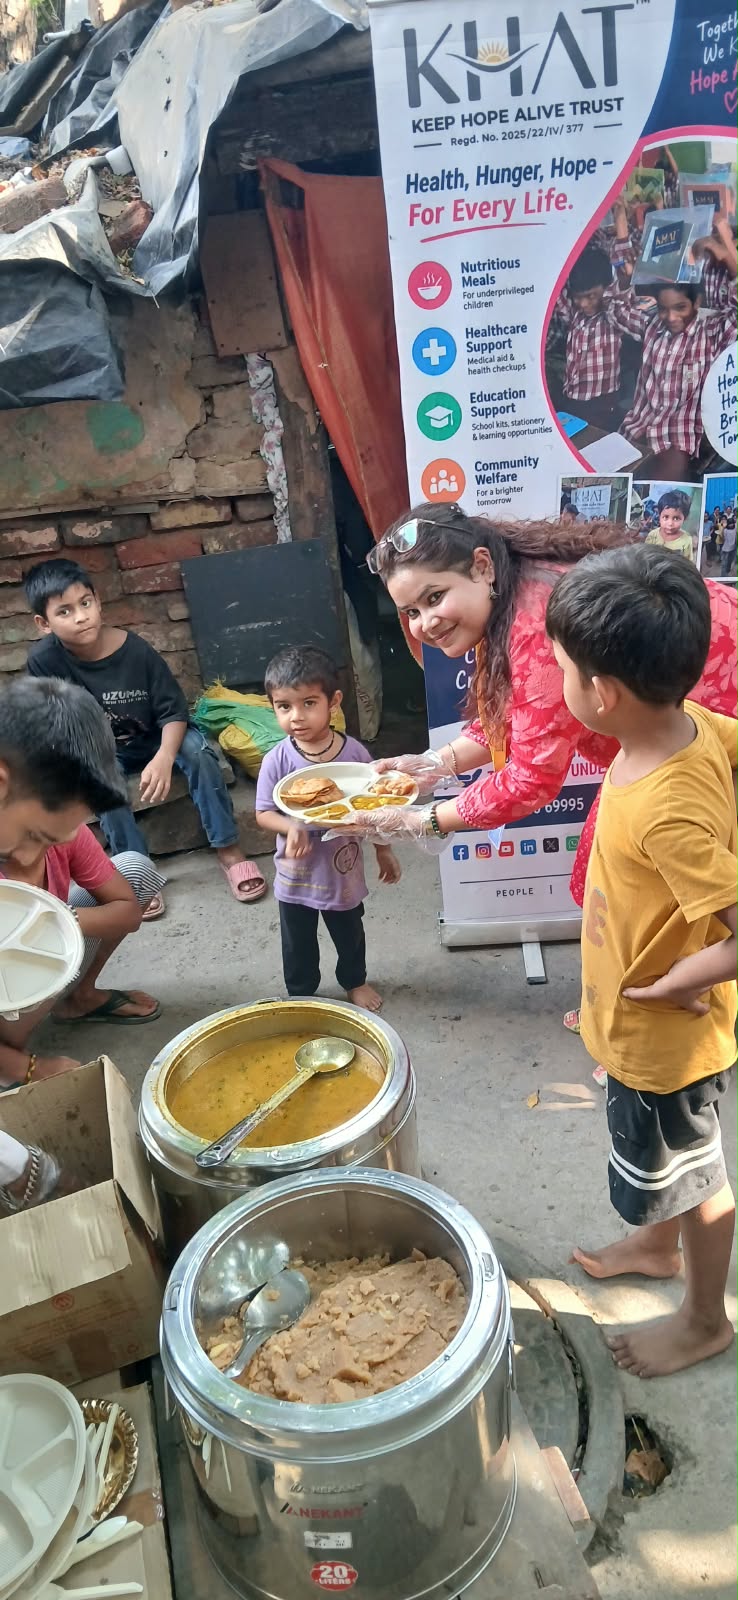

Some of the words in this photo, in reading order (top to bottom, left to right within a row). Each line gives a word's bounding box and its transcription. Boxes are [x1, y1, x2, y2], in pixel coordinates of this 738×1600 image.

[403, 3, 635, 108] KHAT
[703, 43, 725, 65] We
[690, 67, 728, 95] Hope
[412, 116, 456, 133] KEEP
[461, 109, 509, 128] HOPE
[514, 103, 565, 122] ALIVE
[569, 97, 624, 116] TRUST
[451, 134, 479, 147] Regd.
[482, 133, 498, 143] No.
[406, 168, 470, 194] Health,
[475, 161, 544, 190] Hunger,
[550, 155, 597, 183] Hope
[408, 203, 445, 227] For
[452, 197, 516, 224] Every
[524, 187, 574, 215] Life.
[460, 258, 520, 274] Nutritious
[462, 274, 496, 288] Meals
[462, 291, 474, 299] For
[477, 285, 534, 298] underprivileged
[464, 301, 493, 310] children
[465, 324, 528, 339] Healthcare
[466, 338, 512, 354] Support
[468, 356, 495, 365] Medical
[496, 354, 508, 362] aid
[726, 354, 735, 371] A
[468, 366, 491, 375] health
[492, 363, 526, 374] checkups
[470, 388, 526, 404] Education
[470, 402, 516, 418] Support
[472, 422, 494, 431] School
[496, 420, 510, 429] kits,
[511, 417, 545, 428] stationery
[479, 430, 506, 440] learning
[508, 426, 552, 438] opportunities
[474, 456, 539, 472] Community
[475, 472, 518, 486] Welfare
[476, 489, 488, 497] For
[496, 485, 524, 496] brighter
[477, 496, 512, 506] tomorrow
[496, 887, 534, 897] PEOPLE
[320, 1565, 348, 1578] 20
